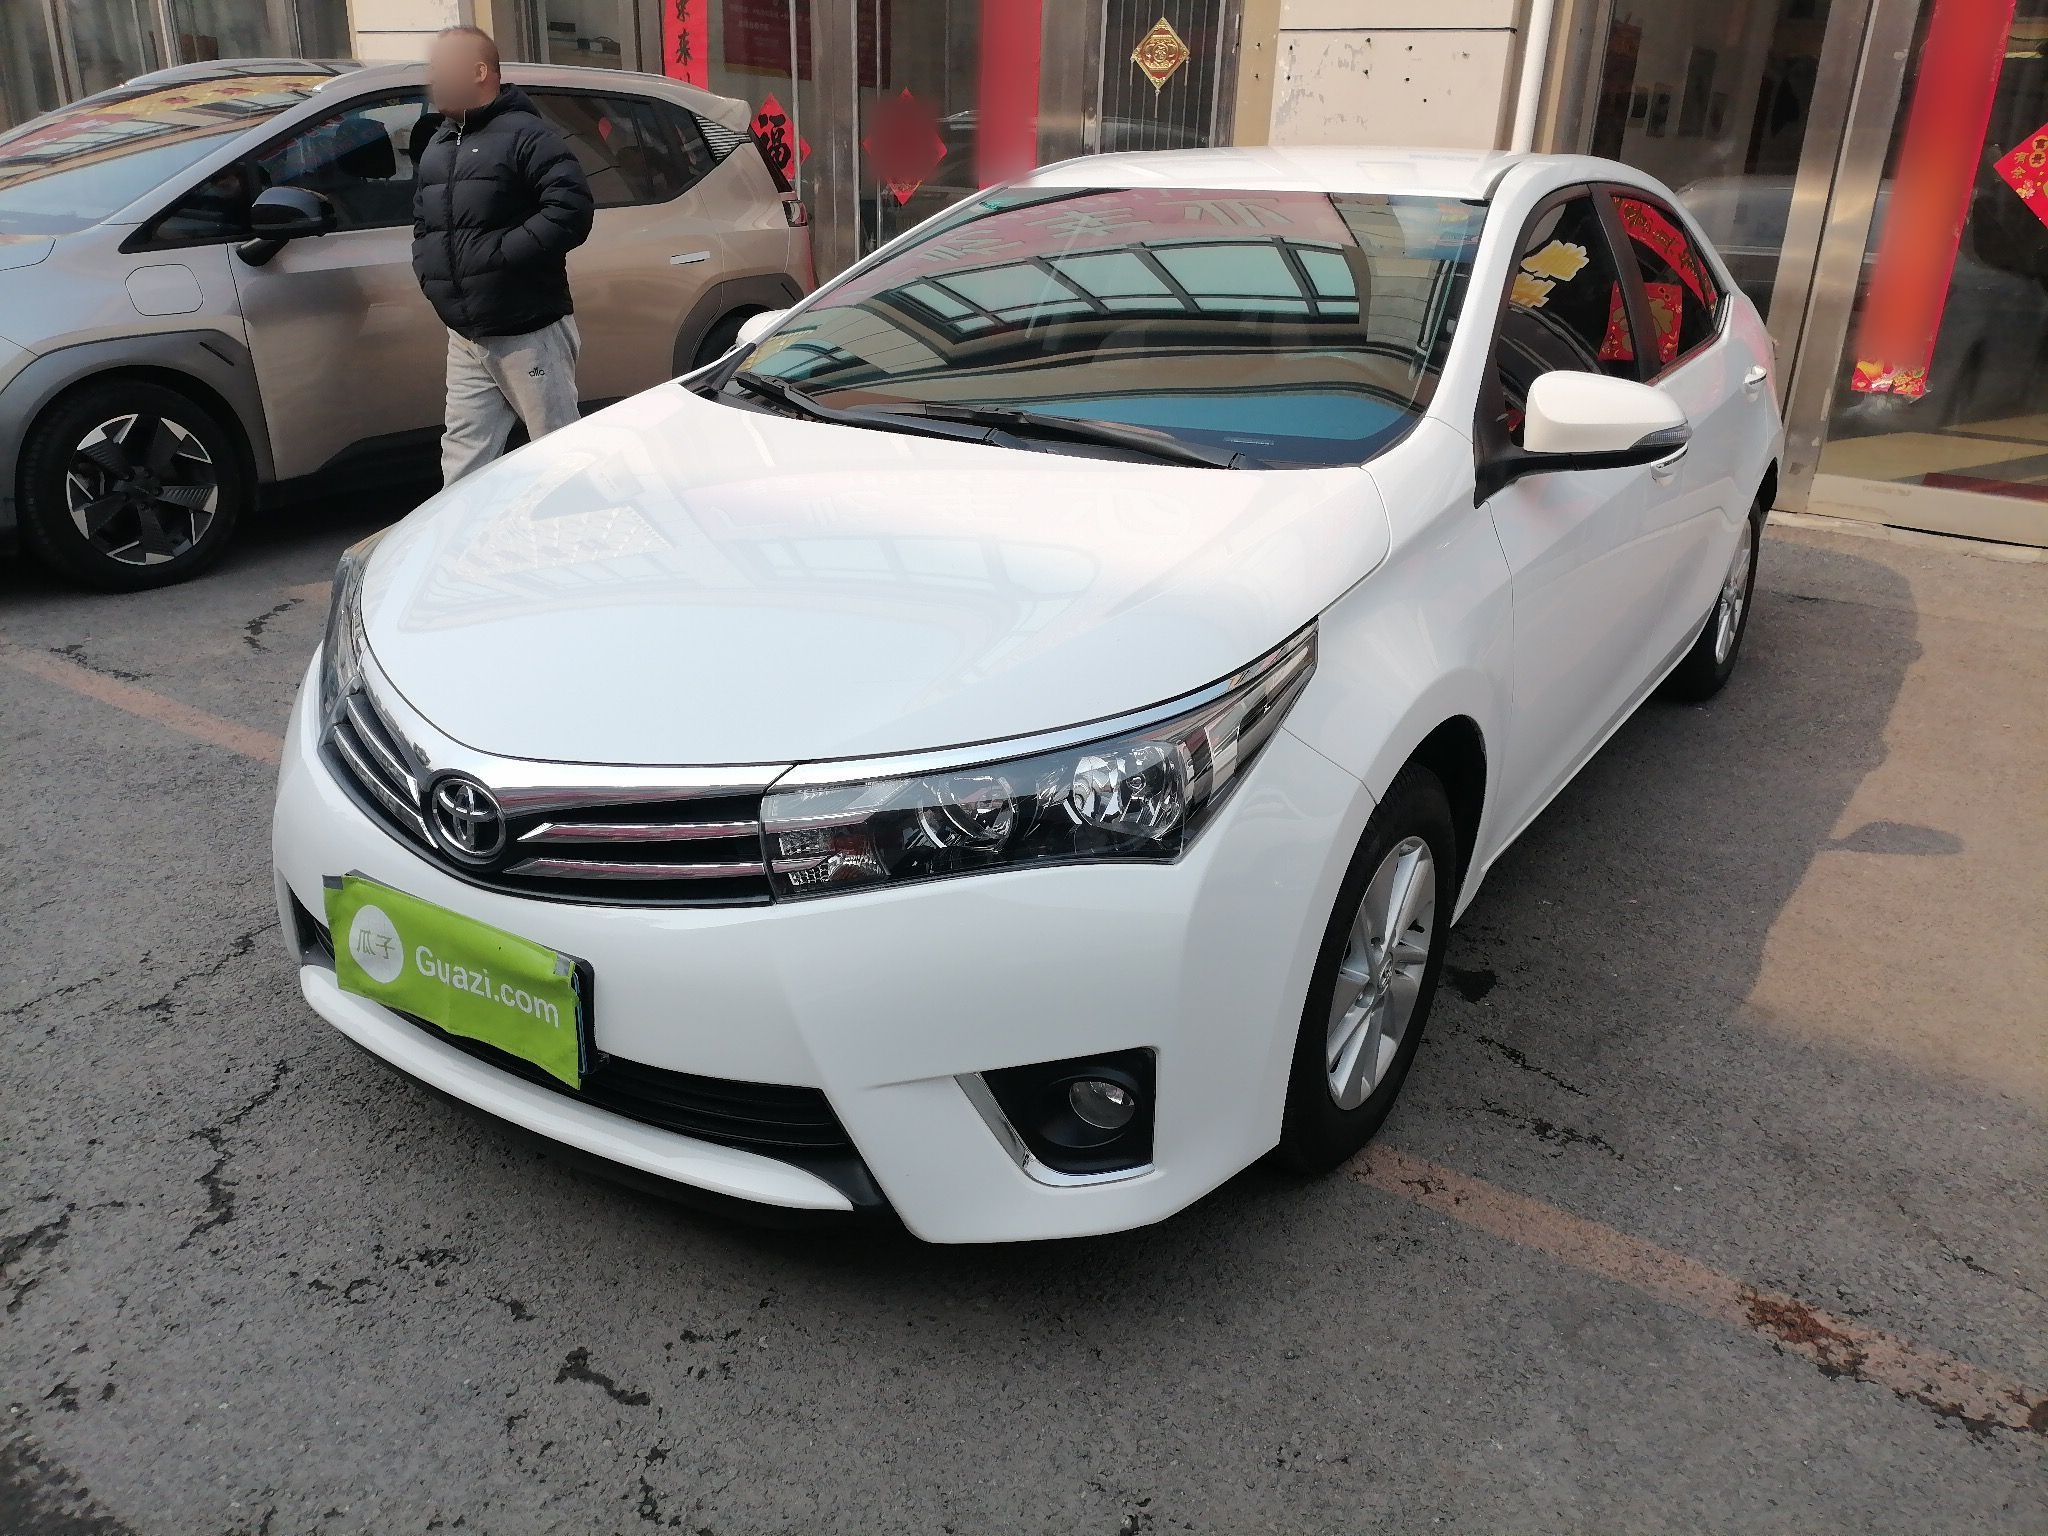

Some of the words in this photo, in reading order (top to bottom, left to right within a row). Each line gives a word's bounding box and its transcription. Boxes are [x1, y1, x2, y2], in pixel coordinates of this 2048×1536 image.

[757, 113, 792, 169] 福
[357, 928, 395, 959] 瓜子
[415, 945, 560, 1028] Guazi.com
